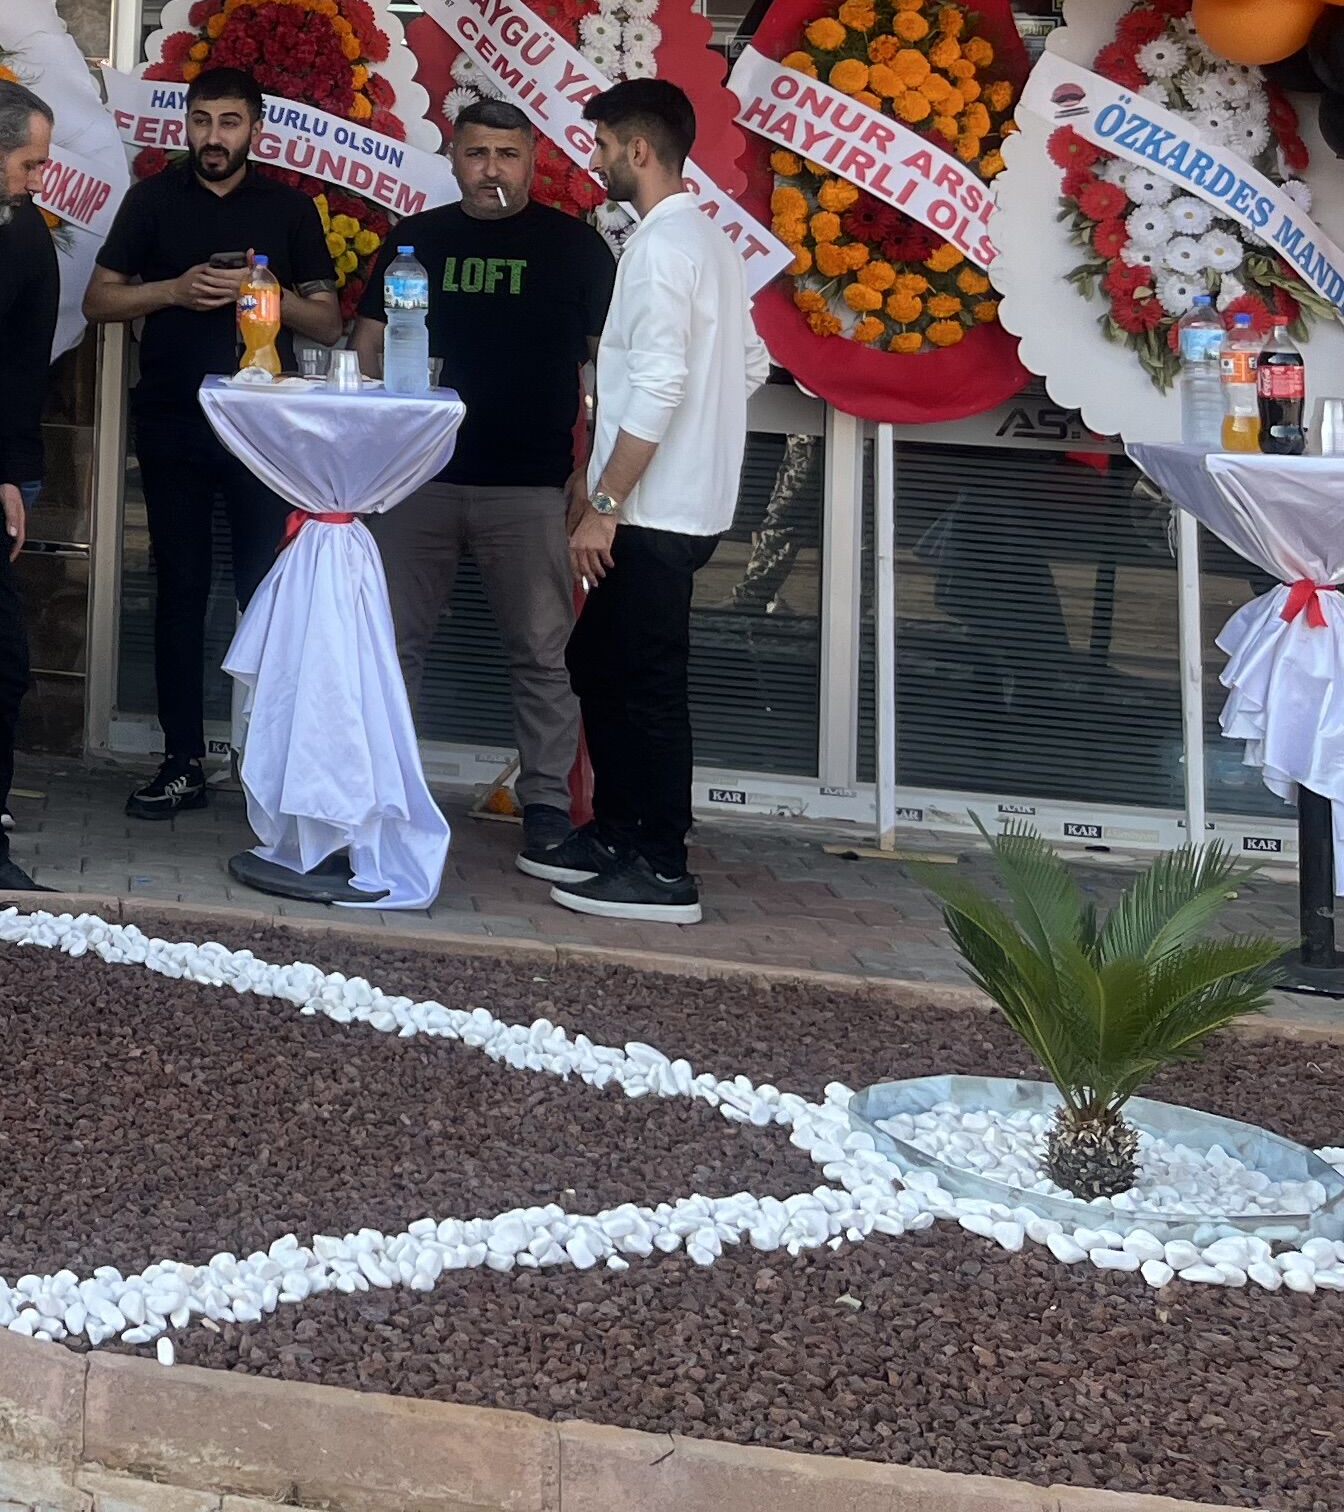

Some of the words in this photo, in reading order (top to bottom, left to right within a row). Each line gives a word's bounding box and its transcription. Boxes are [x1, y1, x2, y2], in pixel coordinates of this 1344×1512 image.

[456, 15, 550, 121] CEMİL
[770, 74, 897, 155] ONUR
[251, 132, 428, 214] GÜNDEM
[333, 126, 405, 169] OLSUN
[742, 96, 919, 207] HAYIRLI
[1093, 94, 1276, 232] ÖZKARDEŞ
[441, 256, 528, 295] LOFT
[711, 790, 744, 804] KAR
[1066, 824, 1100, 838] KAR
[1246, 838, 1278, 851] KAR
